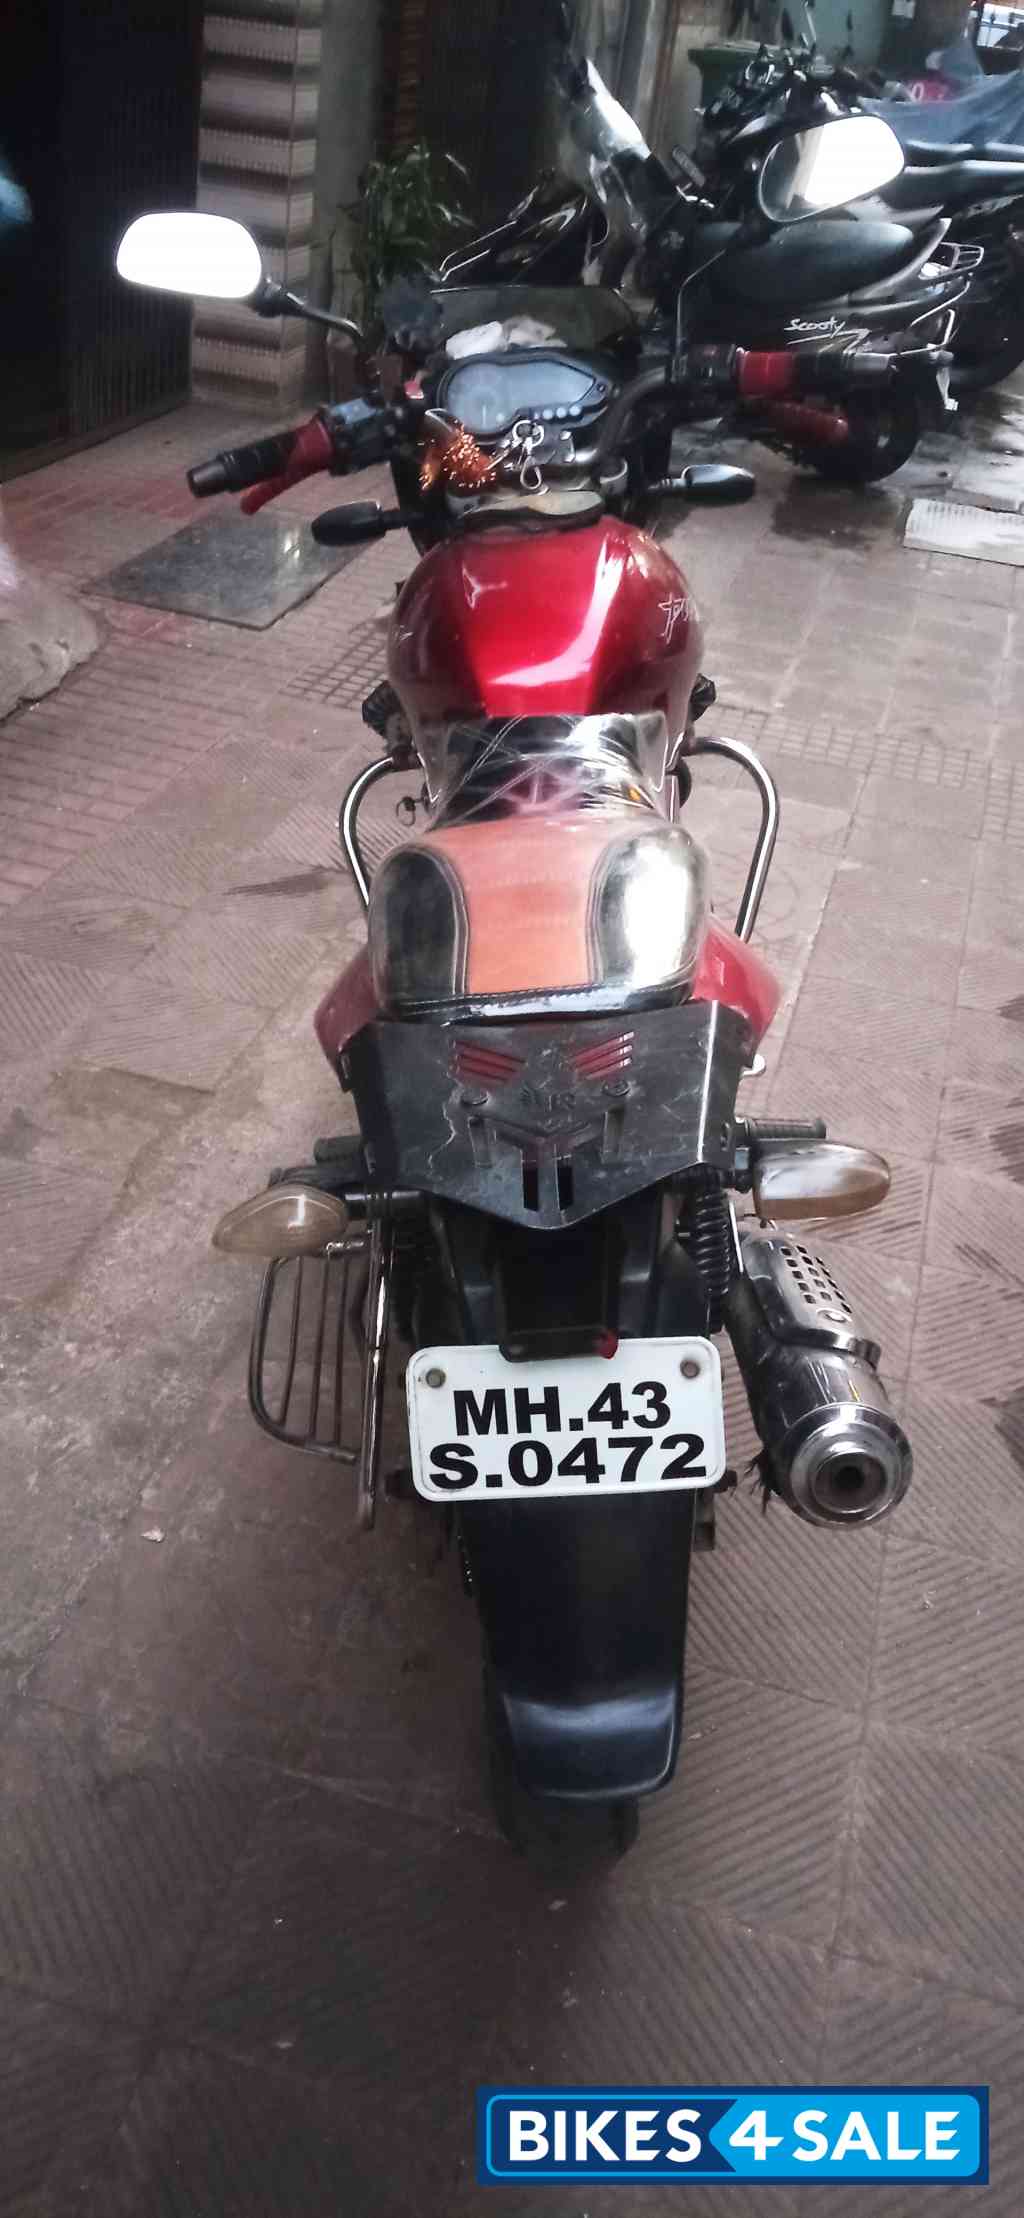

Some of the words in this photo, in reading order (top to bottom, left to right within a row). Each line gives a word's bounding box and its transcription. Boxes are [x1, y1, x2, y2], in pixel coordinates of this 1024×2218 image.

[784, 316, 846, 339] Scooty
[453, 1381, 671, 1436] MH.43
[429, 1433, 707, 1490] S.0472
